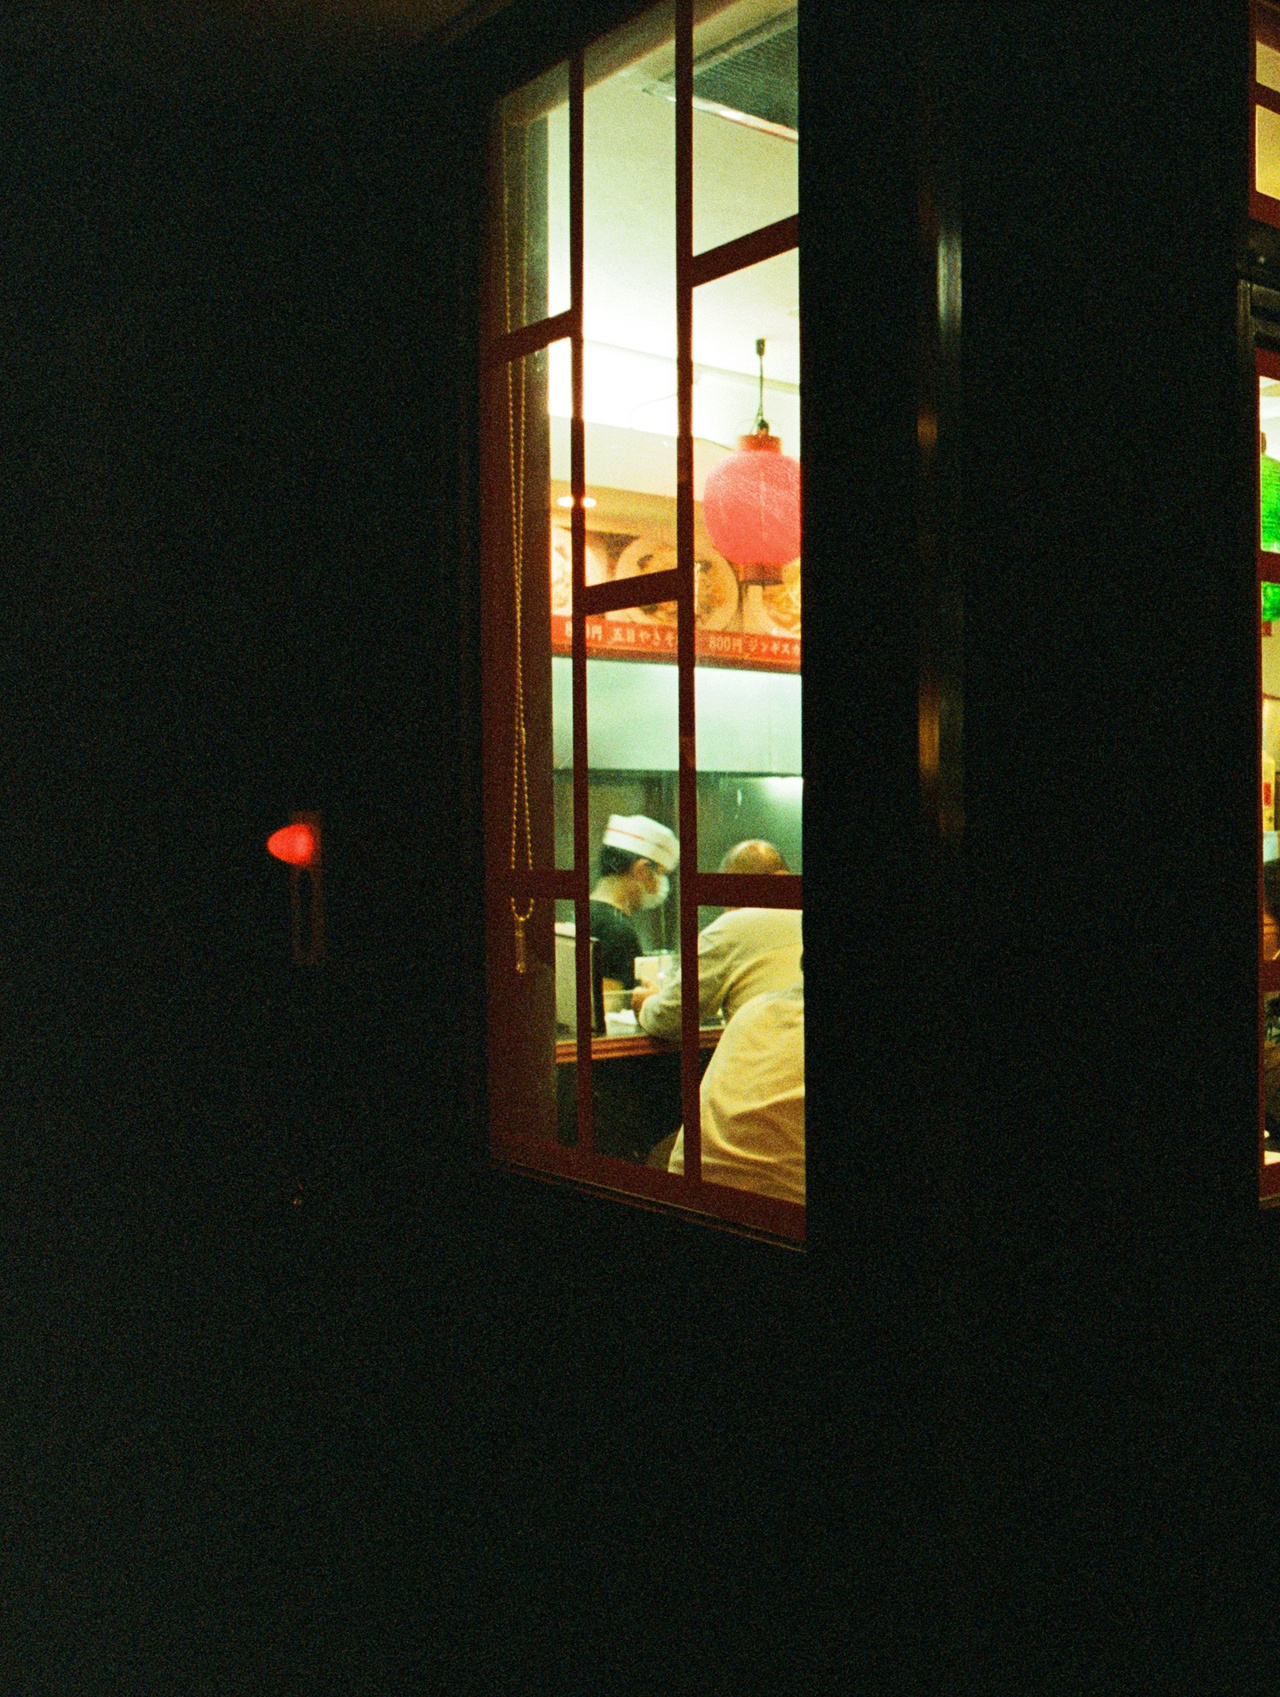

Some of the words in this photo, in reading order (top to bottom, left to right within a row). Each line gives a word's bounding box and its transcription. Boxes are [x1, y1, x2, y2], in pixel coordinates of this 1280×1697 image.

[612, 626, 676, 648] 五目やきそ
